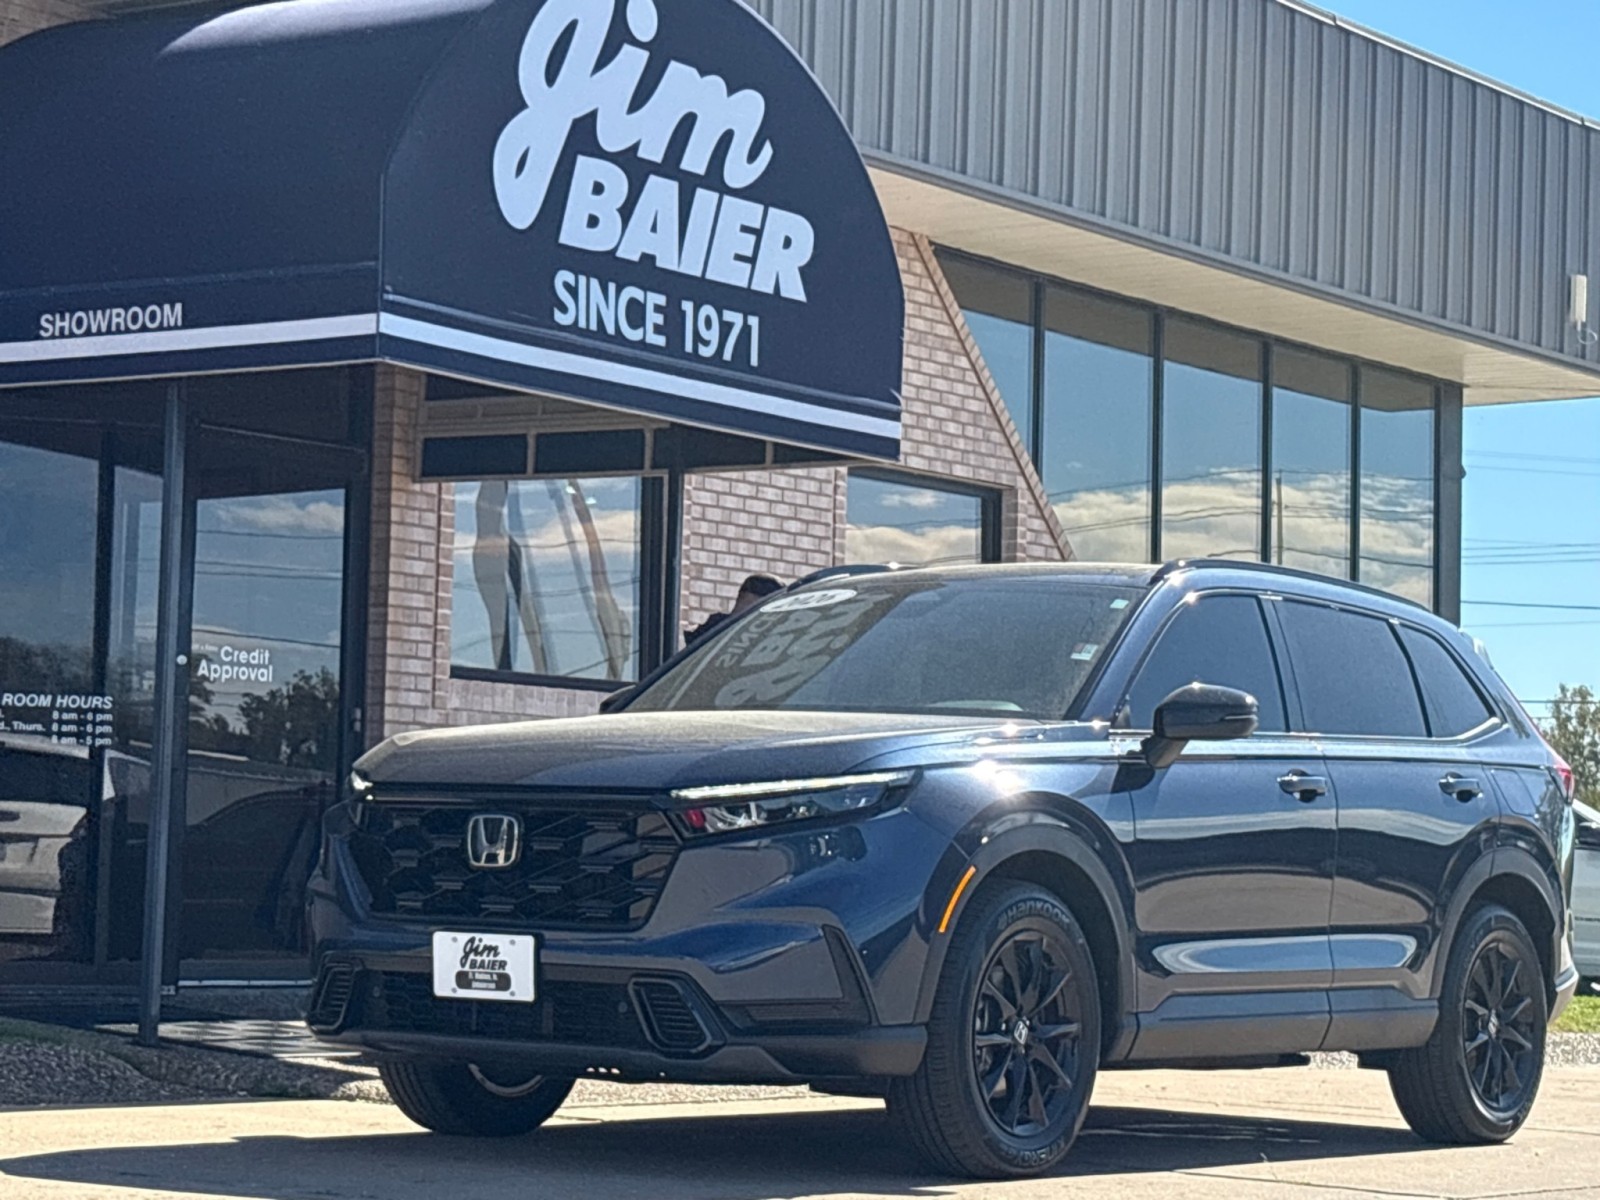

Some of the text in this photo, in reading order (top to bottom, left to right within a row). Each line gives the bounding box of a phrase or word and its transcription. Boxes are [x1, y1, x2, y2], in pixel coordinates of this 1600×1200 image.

[493, 0, 774, 230] Jim
[558, 154, 815, 304] BAIER
[39, 302, 183, 338] SHOWROOM
[553, 269, 760, 367] SINCE 1971
[220, 645, 270, 665] Credit
[197, 659, 273, 683] Approval
[2, 693, 113, 709] ROOM HOURS
[12, 721, 46, 731] Thurs.
[60, 724, 77, 732] am
[95, 725, 113, 735] pm
[61, 712, 78, 720] am
[96, 713, 113, 722] pm
[60, 736, 77, 744] am
[95, 737, 112, 747] pm
[459, 936, 501, 969] Jim
[469, 958, 508, 971] BAIER
